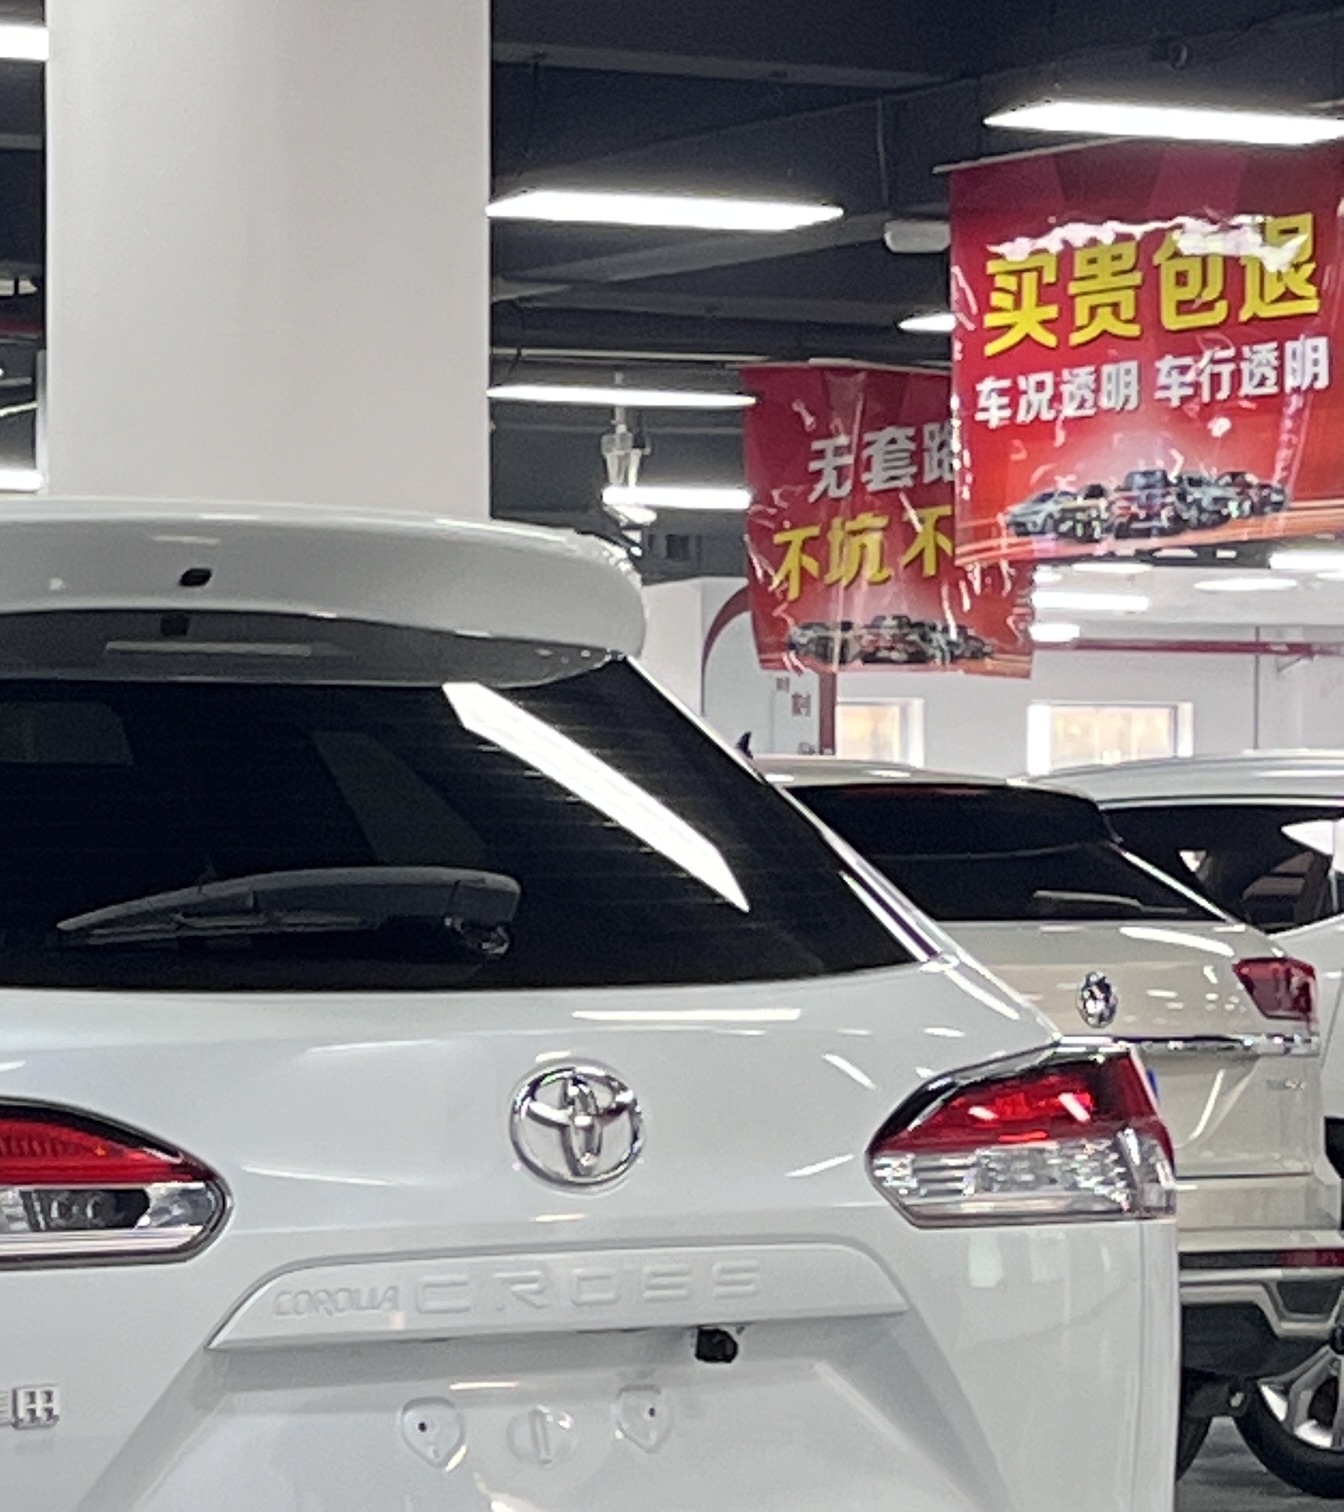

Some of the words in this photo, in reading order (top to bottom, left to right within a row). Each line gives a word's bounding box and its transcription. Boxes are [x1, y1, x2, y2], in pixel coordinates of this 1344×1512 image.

[983, 212, 1320, 358] 买贵包退
[973, 359, 1140, 430] 车况透明
[1153, 336, 1330, 408] 车行透明
[271, 1283, 402, 1320] COROLLA
[414, 1258, 764, 1315] CROSS
